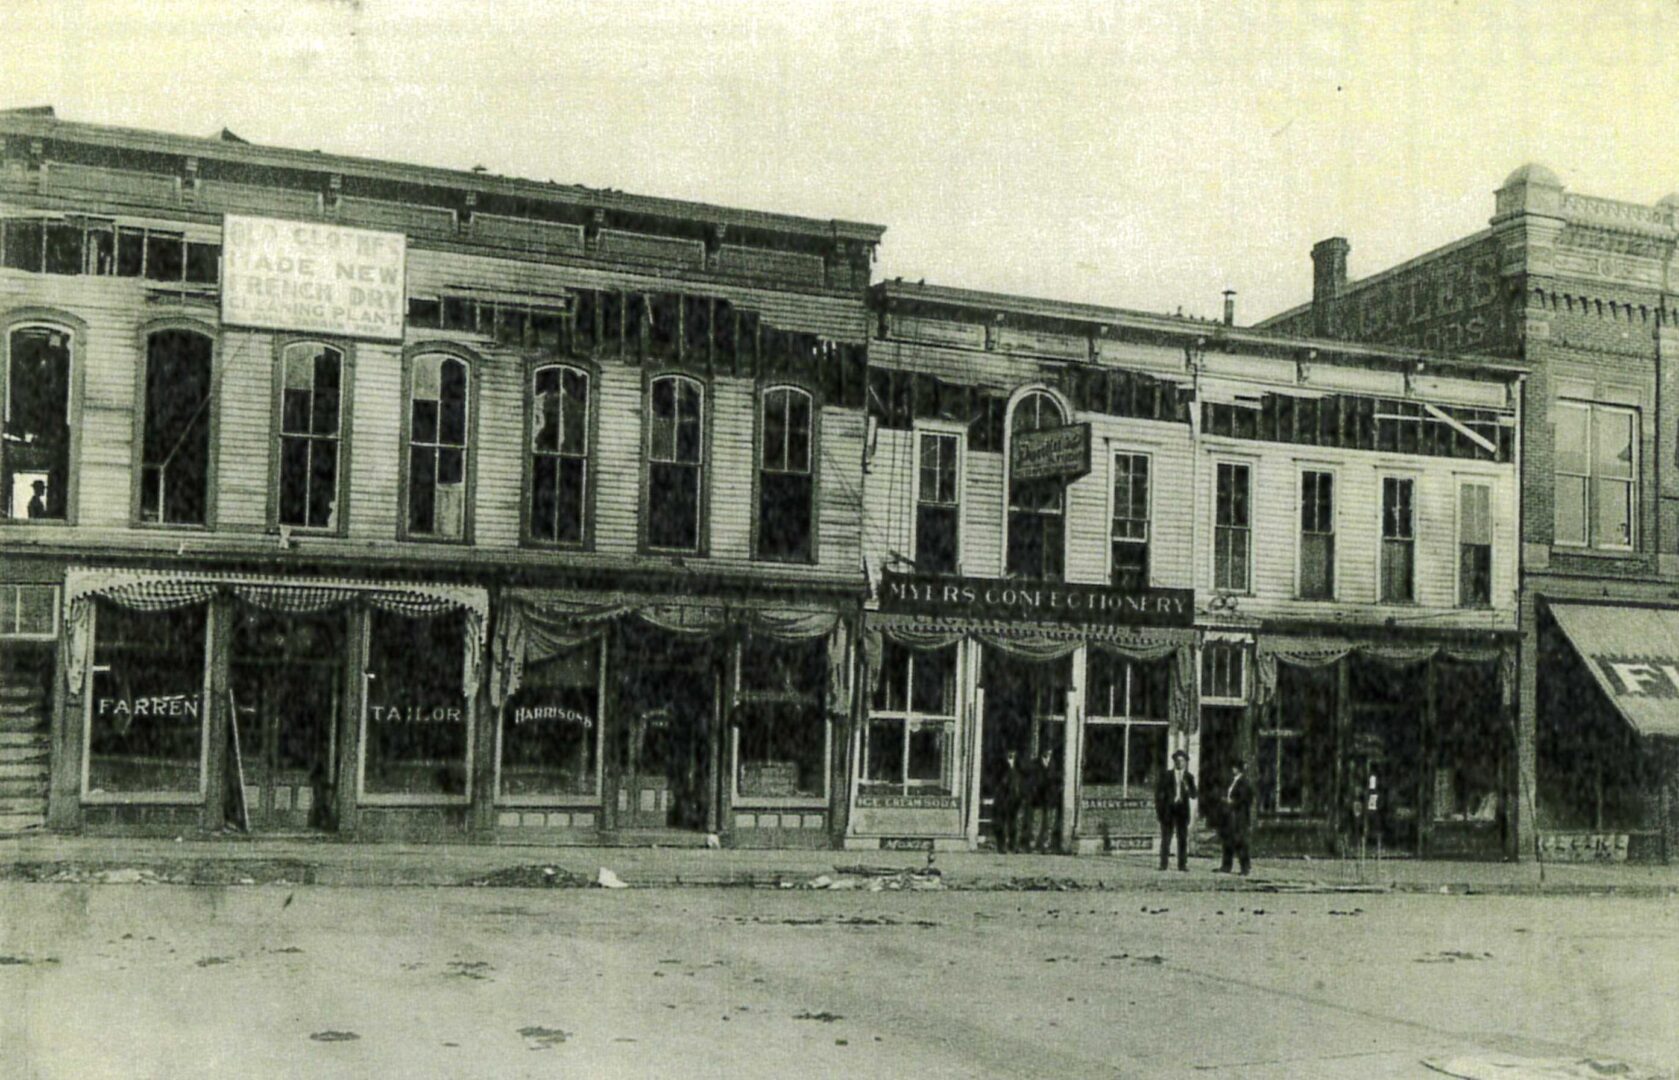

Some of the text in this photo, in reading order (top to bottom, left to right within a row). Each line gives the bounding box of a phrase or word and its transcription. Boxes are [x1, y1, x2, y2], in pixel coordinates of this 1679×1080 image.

[335, 260, 399, 285] NEW
[228, 274, 400, 311] FRENCH DRY
[228, 295, 325, 318] CLEANING
[890, 582, 1186, 614] MYERS CONFECTIONERY
[98, 697, 199, 718] FARREN
[369, 705, 462, 721] TAILOR
[857, 798, 958, 809] ICE CREAM SODA
